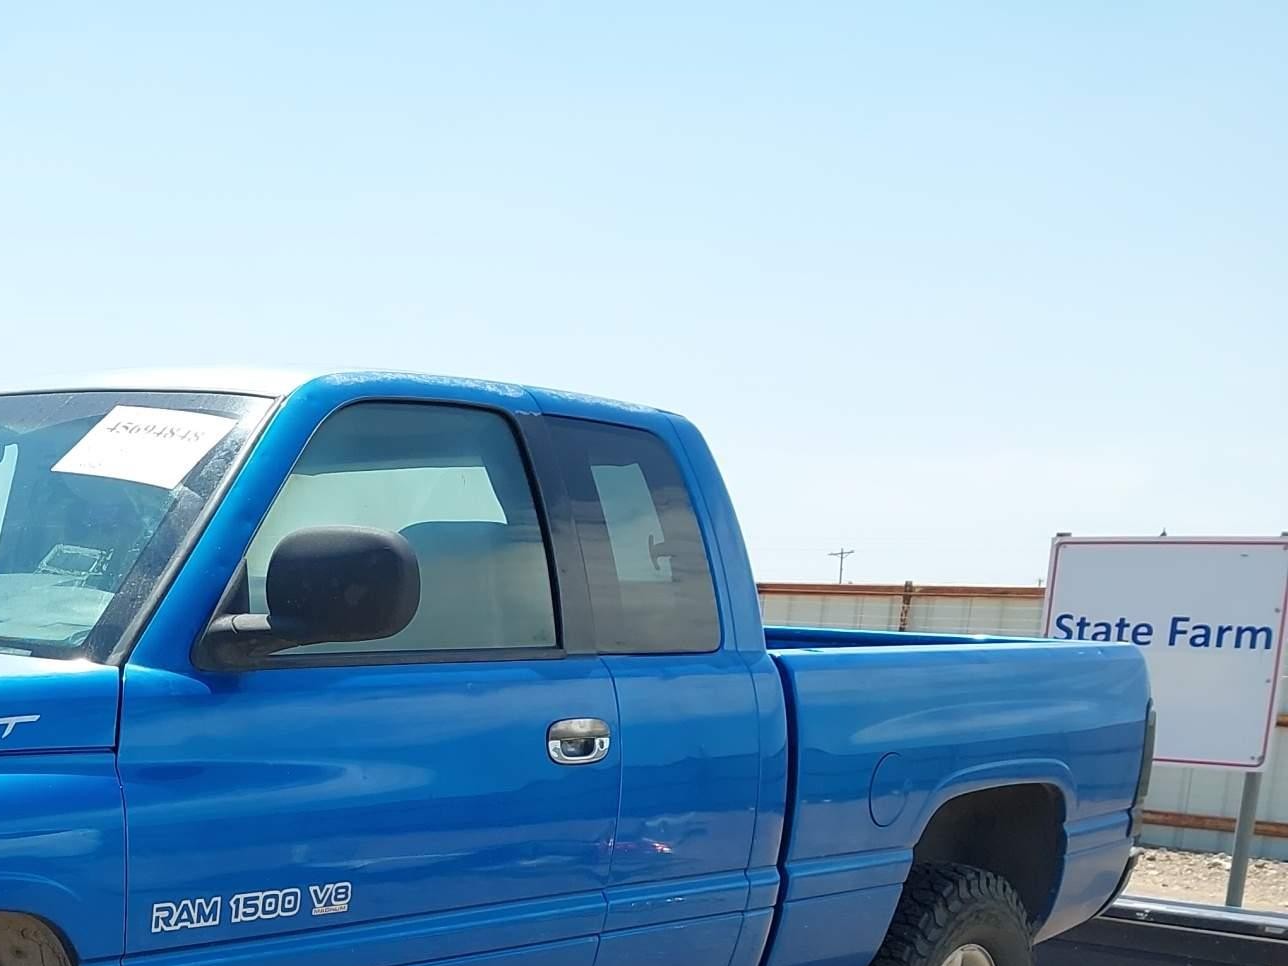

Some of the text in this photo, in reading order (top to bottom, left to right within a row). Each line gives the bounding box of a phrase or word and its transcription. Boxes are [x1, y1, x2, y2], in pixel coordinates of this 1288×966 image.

[1054, 613, 1273, 650] State Farm
[151, 881, 352, 933] RAM 1500 V8
